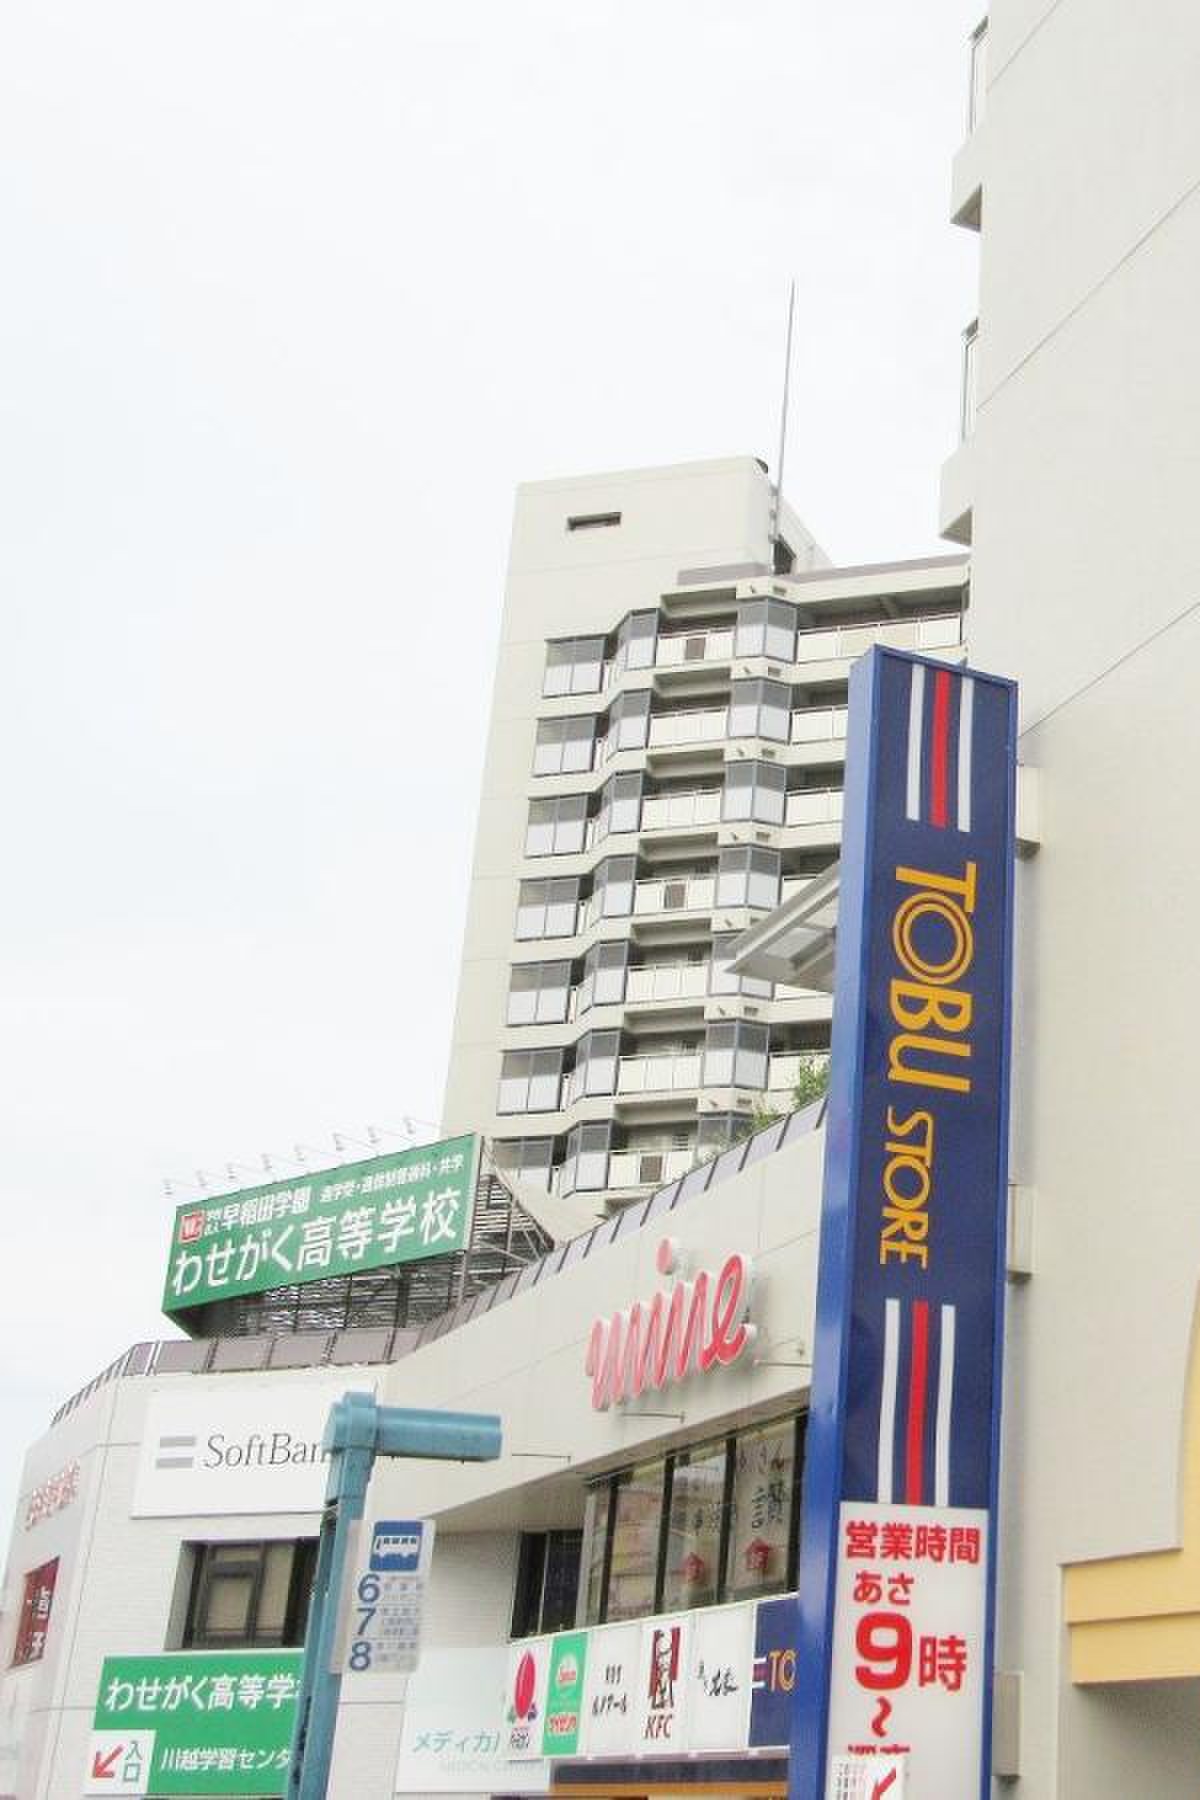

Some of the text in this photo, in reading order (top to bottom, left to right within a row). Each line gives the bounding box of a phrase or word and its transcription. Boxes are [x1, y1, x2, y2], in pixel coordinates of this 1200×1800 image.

[879, 861, 977, 1270] TOBU STORE
[172, 1188, 460, 1294] わせがく高等学校
[845, 1520, 981, 1564] 営業時間
[358, 1574, 380, 1602] 6
[853, 1570, 915, 1606] あさ
[357, 1607, 377, 1635] 7
[350, 1641, 371, 1671] 8
[855, 1611, 968, 1692] 9時
[105, 1673, 302, 1711] わせがく高等学
[413, 1730, 500, 1753] メディカ
[645, 1714, 673, 1738] KFC
[123, 1740, 143, 1782] 入口
